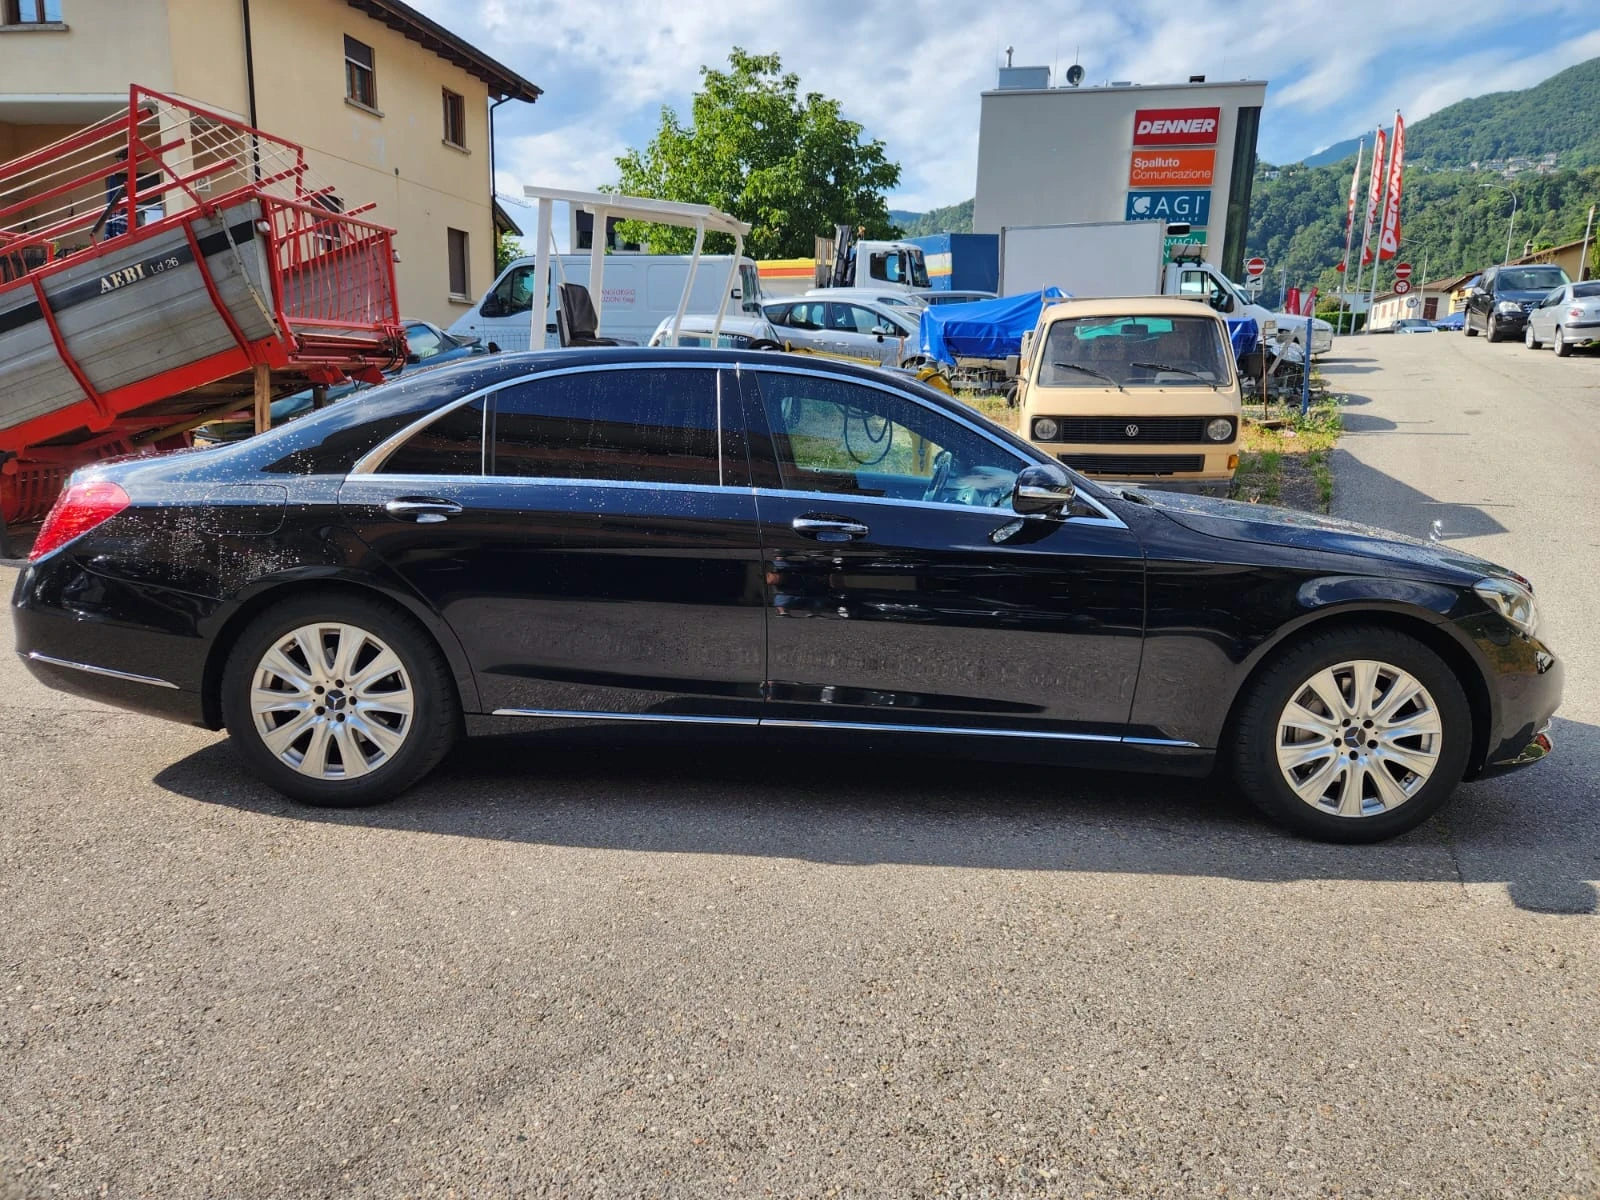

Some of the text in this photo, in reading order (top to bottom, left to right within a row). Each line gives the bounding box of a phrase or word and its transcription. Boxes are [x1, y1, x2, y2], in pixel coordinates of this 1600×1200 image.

[1137, 119, 1215, 135] DENNER
[1134, 158, 1180, 169] Spalluto
[1132, 169, 1211, 180] Comunicazione
[1154, 195, 1202, 215] AGI
[1163, 238, 1199, 247] RMACIA
[100, 257, 179, 294] AEBI Ld 26
